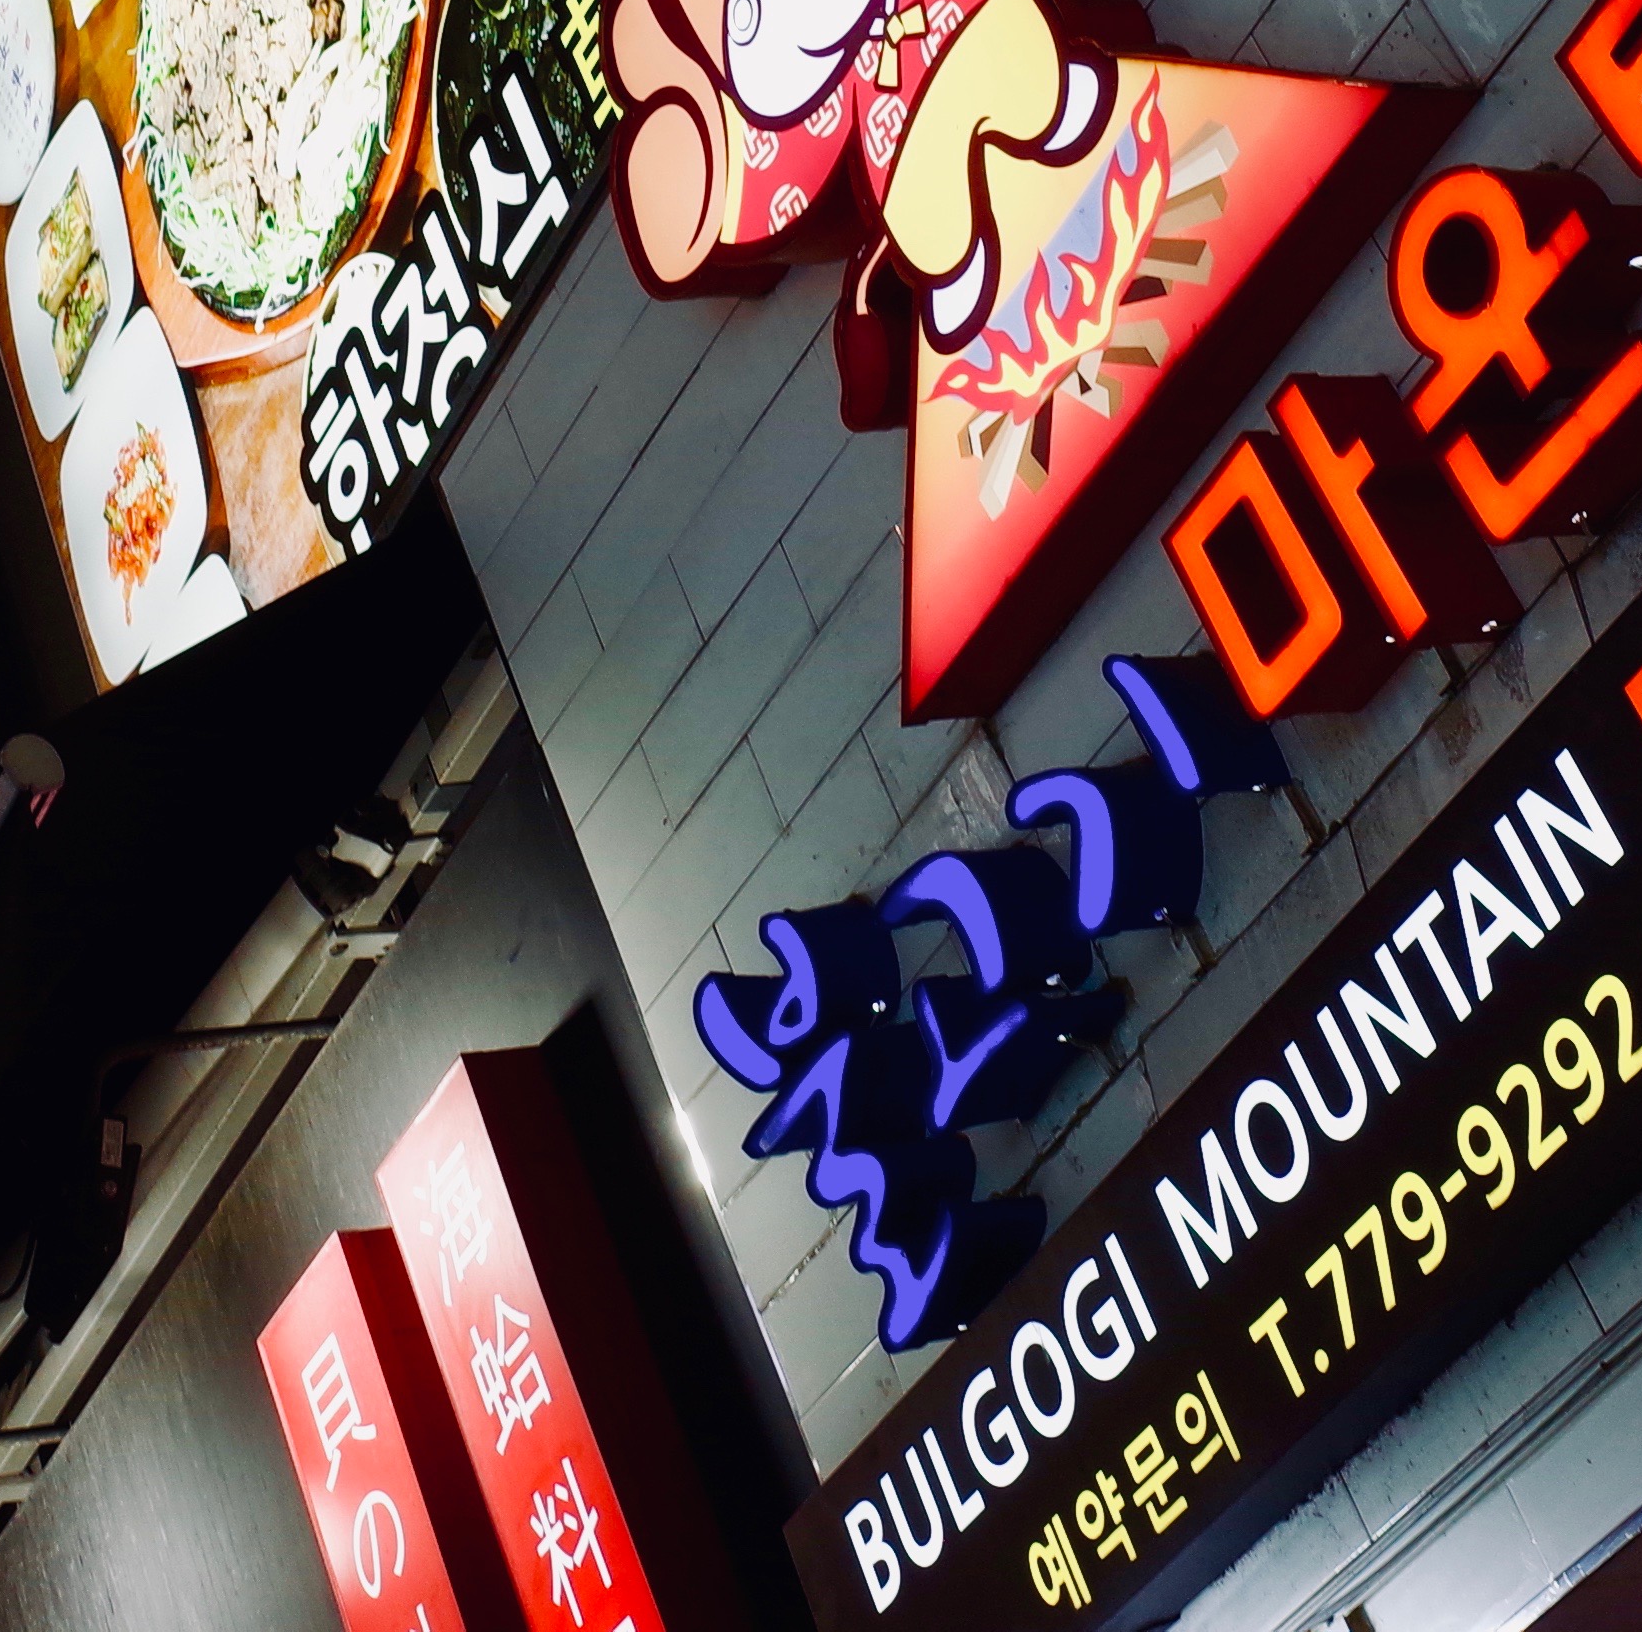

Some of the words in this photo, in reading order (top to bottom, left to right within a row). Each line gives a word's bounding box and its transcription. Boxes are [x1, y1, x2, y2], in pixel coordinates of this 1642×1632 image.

[703, 656, 1198, 1348] 불고기
[844, 1234, 1157, 1614] BULGOGI
[1155, 749, 1625, 1290] MOUNTAIN
[301, 1332, 431, 1632] 貝の
[410, 1142, 639, 1632] 海蛤料
[1027, 1370, 1243, 1610] 예약문의
